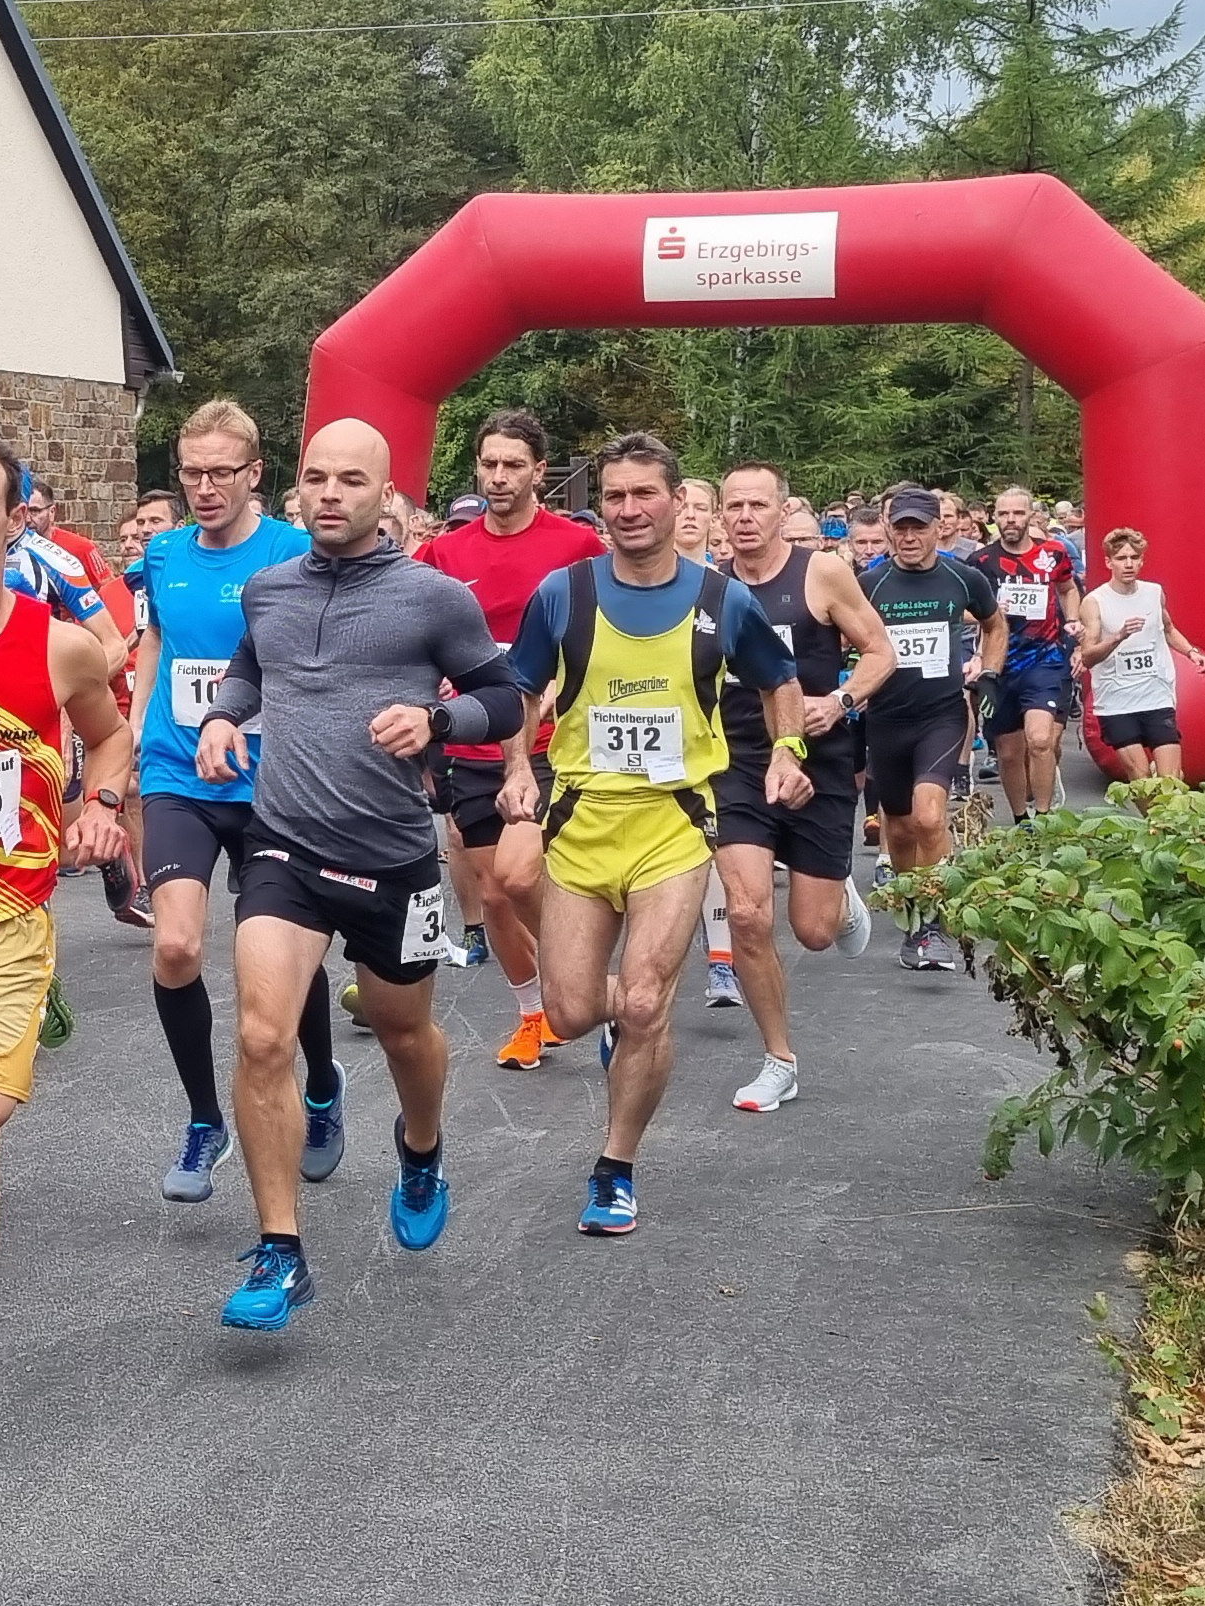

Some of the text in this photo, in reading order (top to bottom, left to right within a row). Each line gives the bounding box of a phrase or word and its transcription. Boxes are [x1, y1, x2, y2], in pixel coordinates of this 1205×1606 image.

[697, 240, 819, 263] Erzgebirgs-
[696, 267, 802, 289] sparkasse
[1011, 593, 1037, 605] 328
[898, 637, 938, 656] 357
[1124, 655, 1153, 670] 138
[594, 712, 675, 726] Fichtelberglauf
[607, 726, 661, 751] 312
